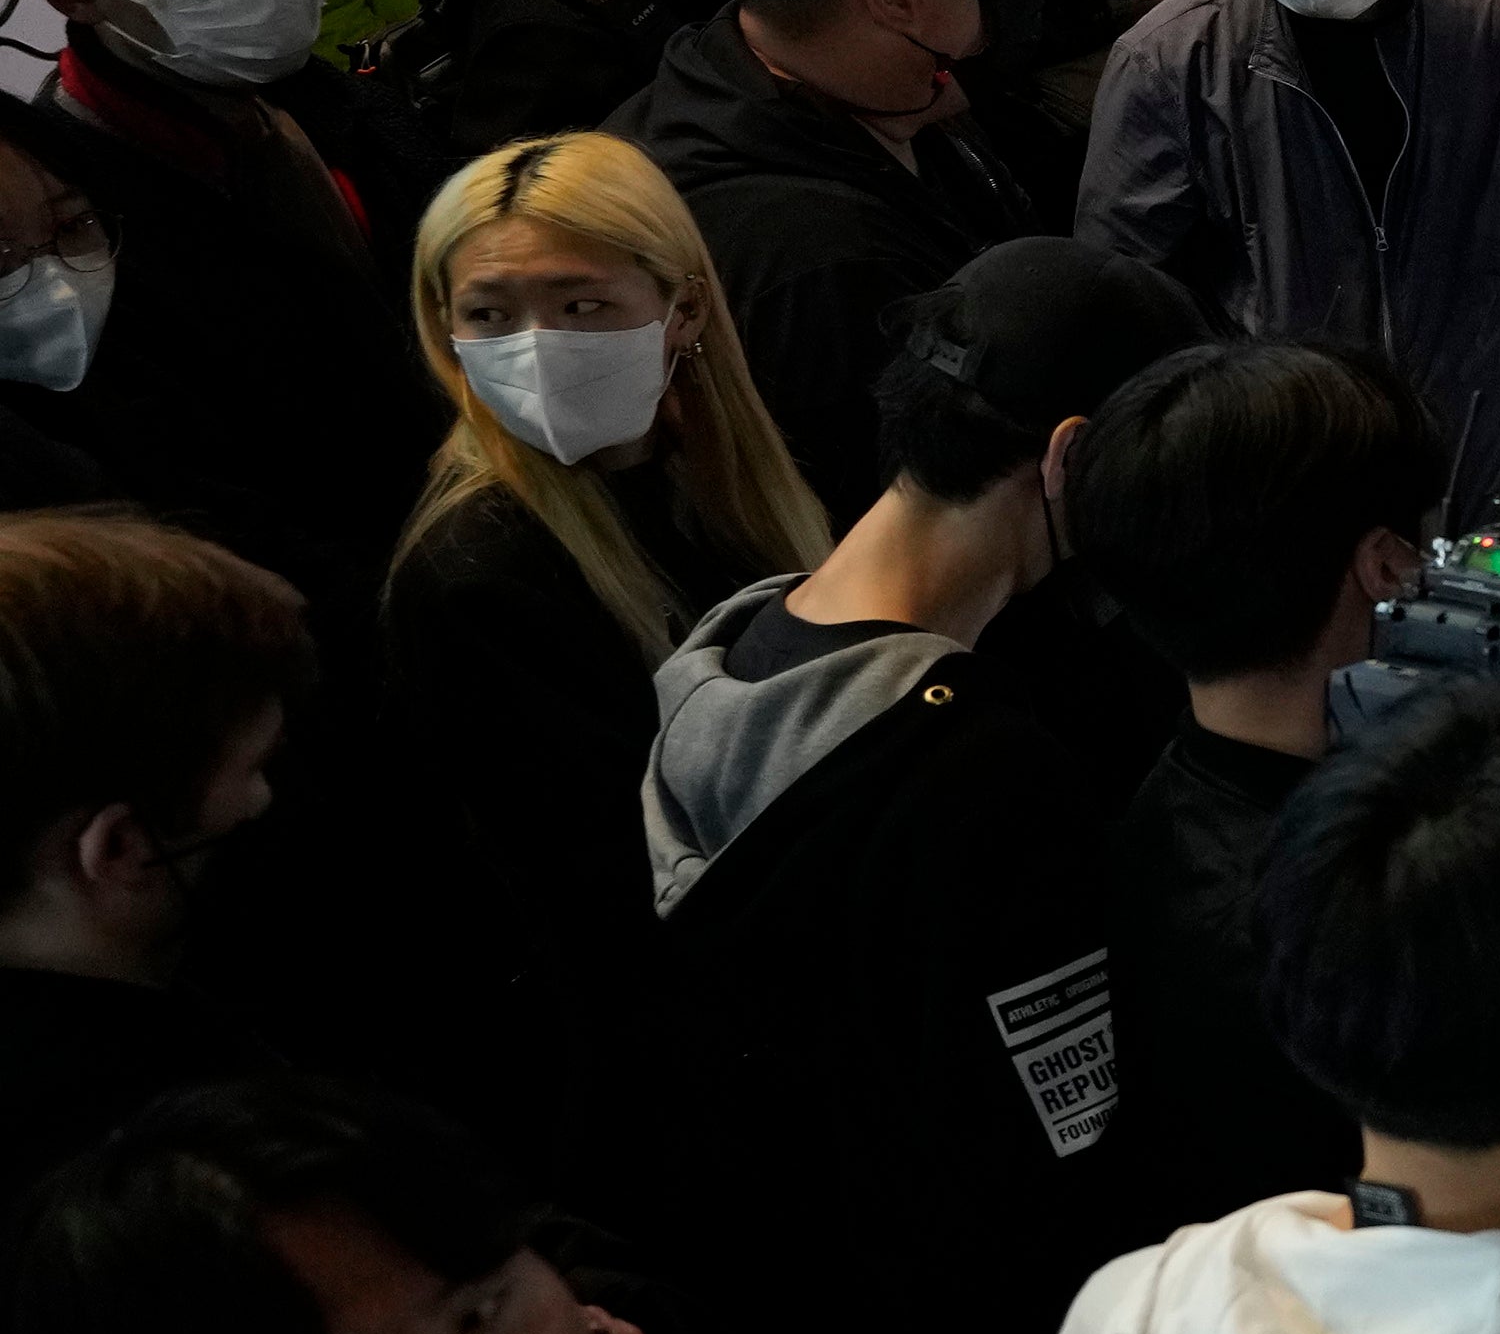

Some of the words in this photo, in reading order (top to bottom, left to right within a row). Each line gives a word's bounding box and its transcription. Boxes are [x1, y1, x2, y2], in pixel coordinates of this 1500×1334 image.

[1007, 994, 1061, 1024] ATHLETIC
[1028, 1030, 1113, 1087] GHOST
[1058, 1109, 1114, 1145] FOUND
